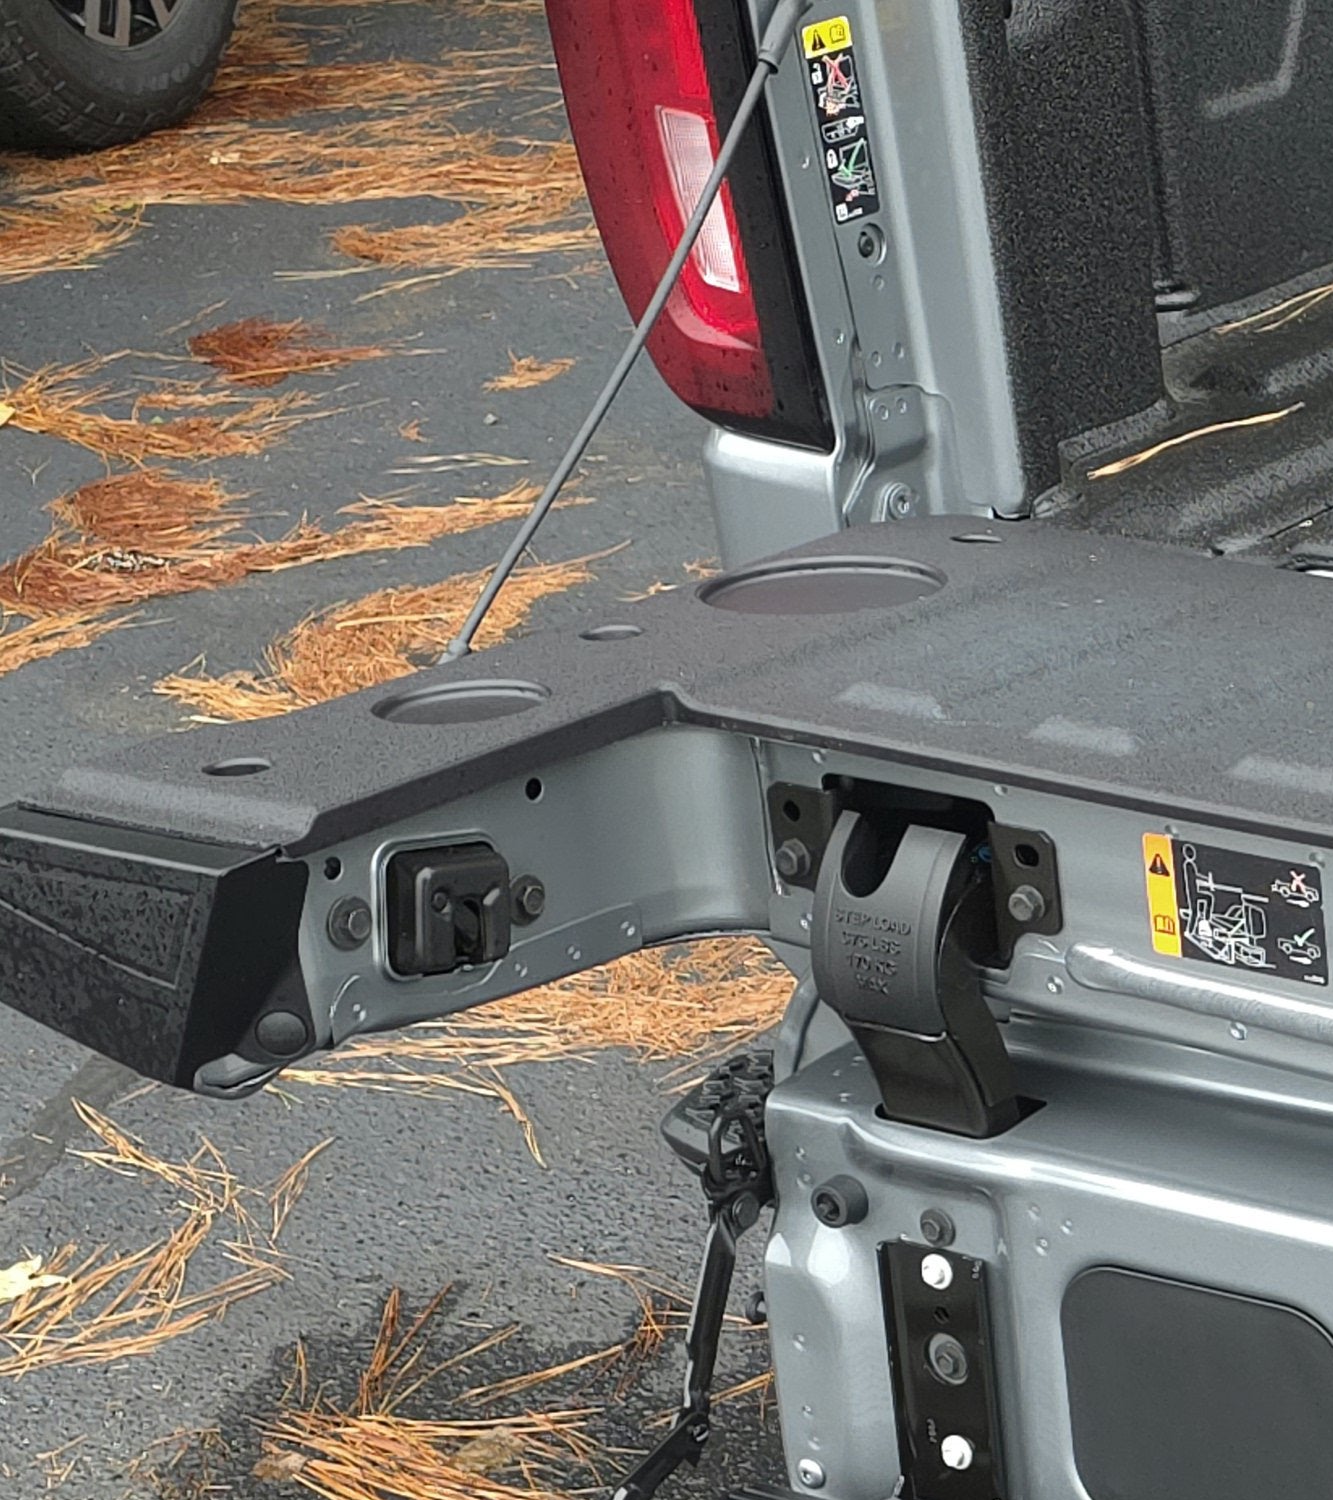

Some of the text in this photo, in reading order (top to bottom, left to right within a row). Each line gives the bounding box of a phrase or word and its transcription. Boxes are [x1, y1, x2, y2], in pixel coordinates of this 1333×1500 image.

[835, 909, 911, 936] STEP LOAD
[846, 952, 871, 971] 170
